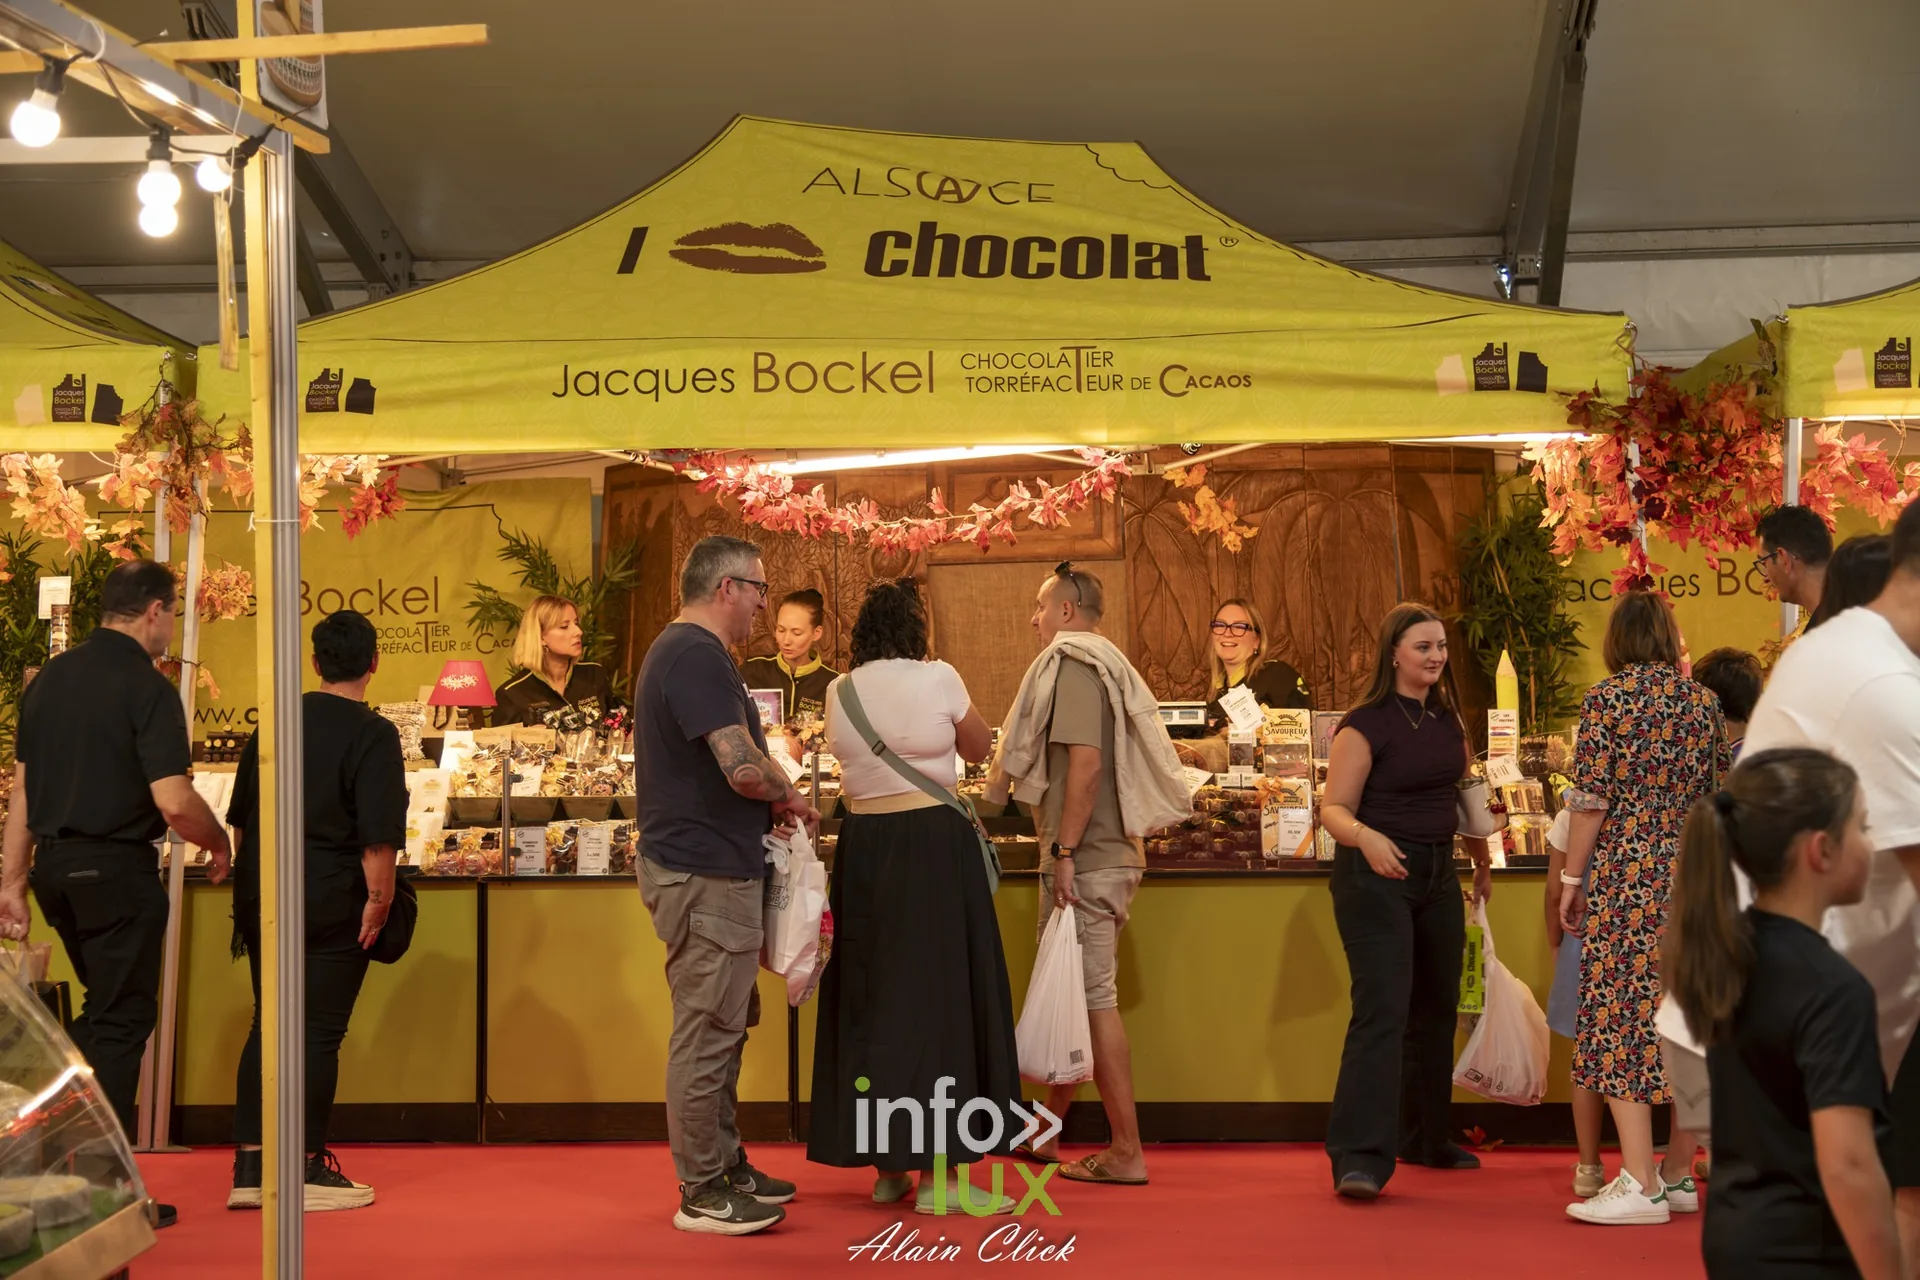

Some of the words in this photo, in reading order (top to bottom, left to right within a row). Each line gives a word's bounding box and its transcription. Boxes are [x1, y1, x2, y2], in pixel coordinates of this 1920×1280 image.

[616, 226, 649, 274] I
[864, 221, 1212, 282] chocolat
[961, 346, 1114, 374] CHOCOLATIER
[1474, 358, 1507, 367] Jacques
[1876, 354, 1910, 362] Jacques
[1475, 366, 1507, 374] Bockel
[1876, 361, 1910, 370] Bockel
[552, 364, 736, 402] Jacques
[754, 350, 935, 395] Bockel
[965, 368, 1124, 394] TORRÉFACTEUR
[1130, 376, 1152, 391] DE
[310, 383, 340, 391] Jacques
[54, 389, 85, 397] Jacques
[54, 396, 85, 405] Bockel
[376, 620, 451, 640] OCOLATIER
[1264, 726, 1308, 737] SAVOUREUX
